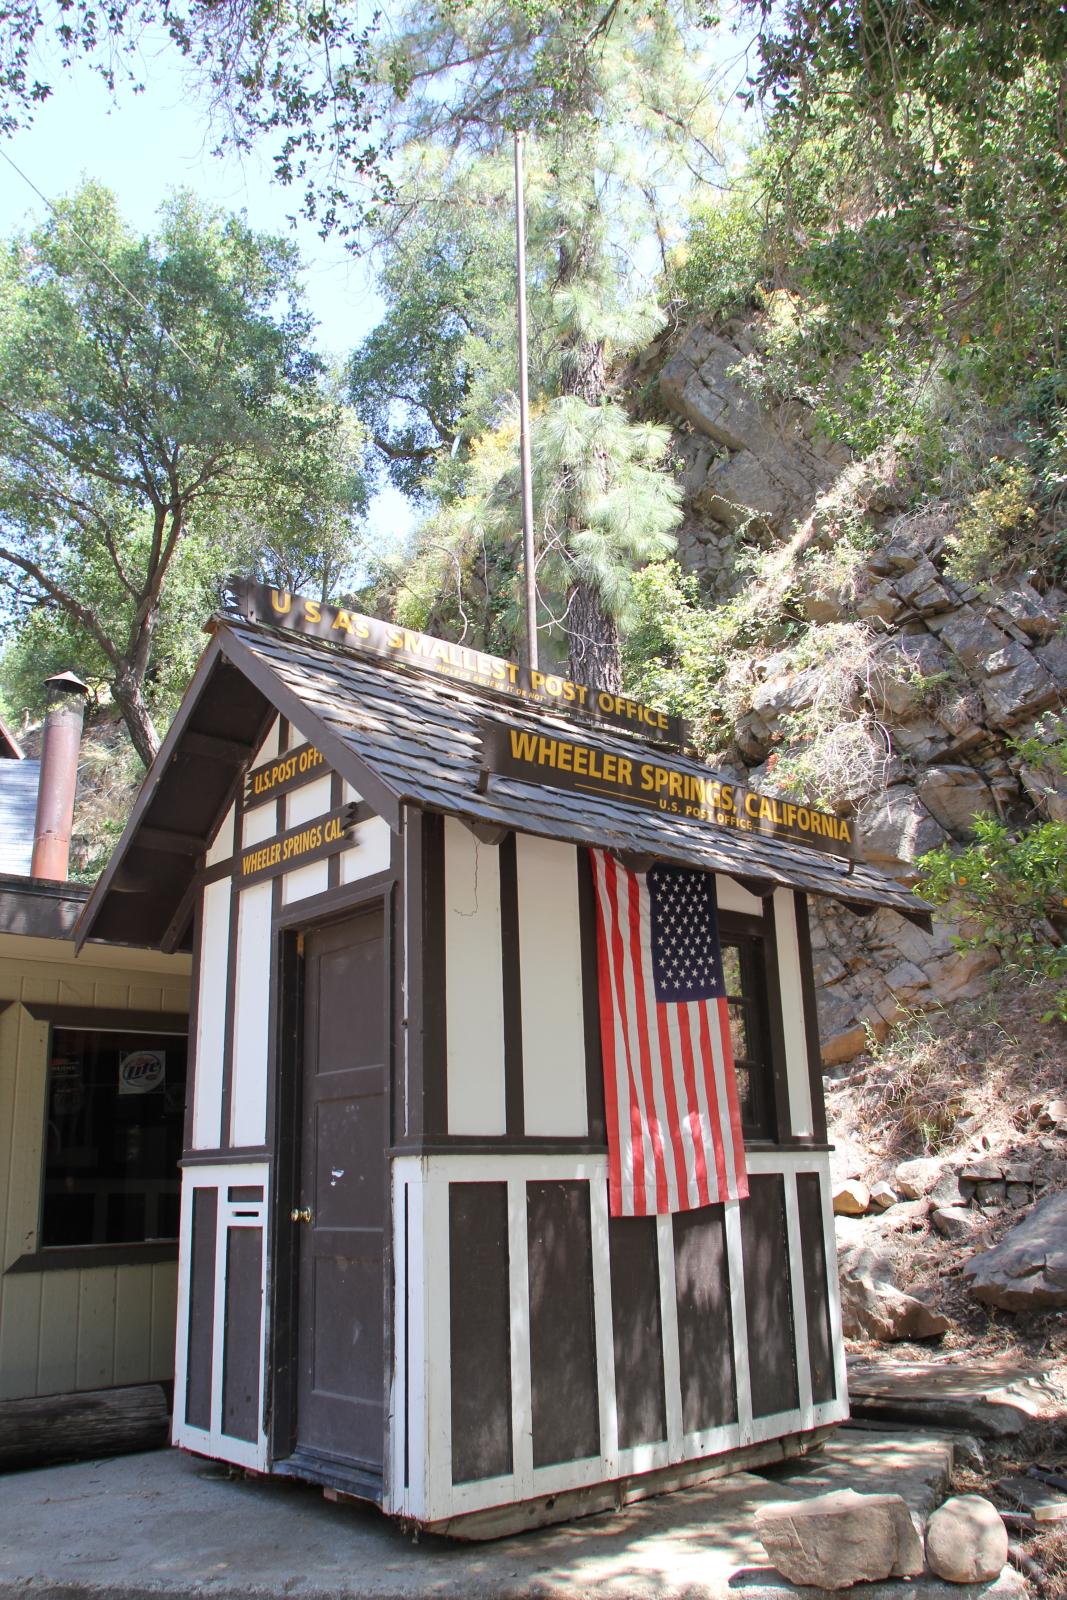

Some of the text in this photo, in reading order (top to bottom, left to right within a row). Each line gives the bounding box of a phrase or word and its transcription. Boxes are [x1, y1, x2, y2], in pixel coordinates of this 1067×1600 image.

[387, 628, 520, 684] SMALLEST
[530, 670, 588, 705] POST
[598, 692, 669, 730] OFFICE
[516, 687, 527, 697] OR
[510, 730, 852, 843] WHEELER SPRINGS, CALIFORNIA
[659, 799, 753, 830] U.S. POST OFFICE
[242, 816, 345, 876] WHEELER SPRINGS CAL.
